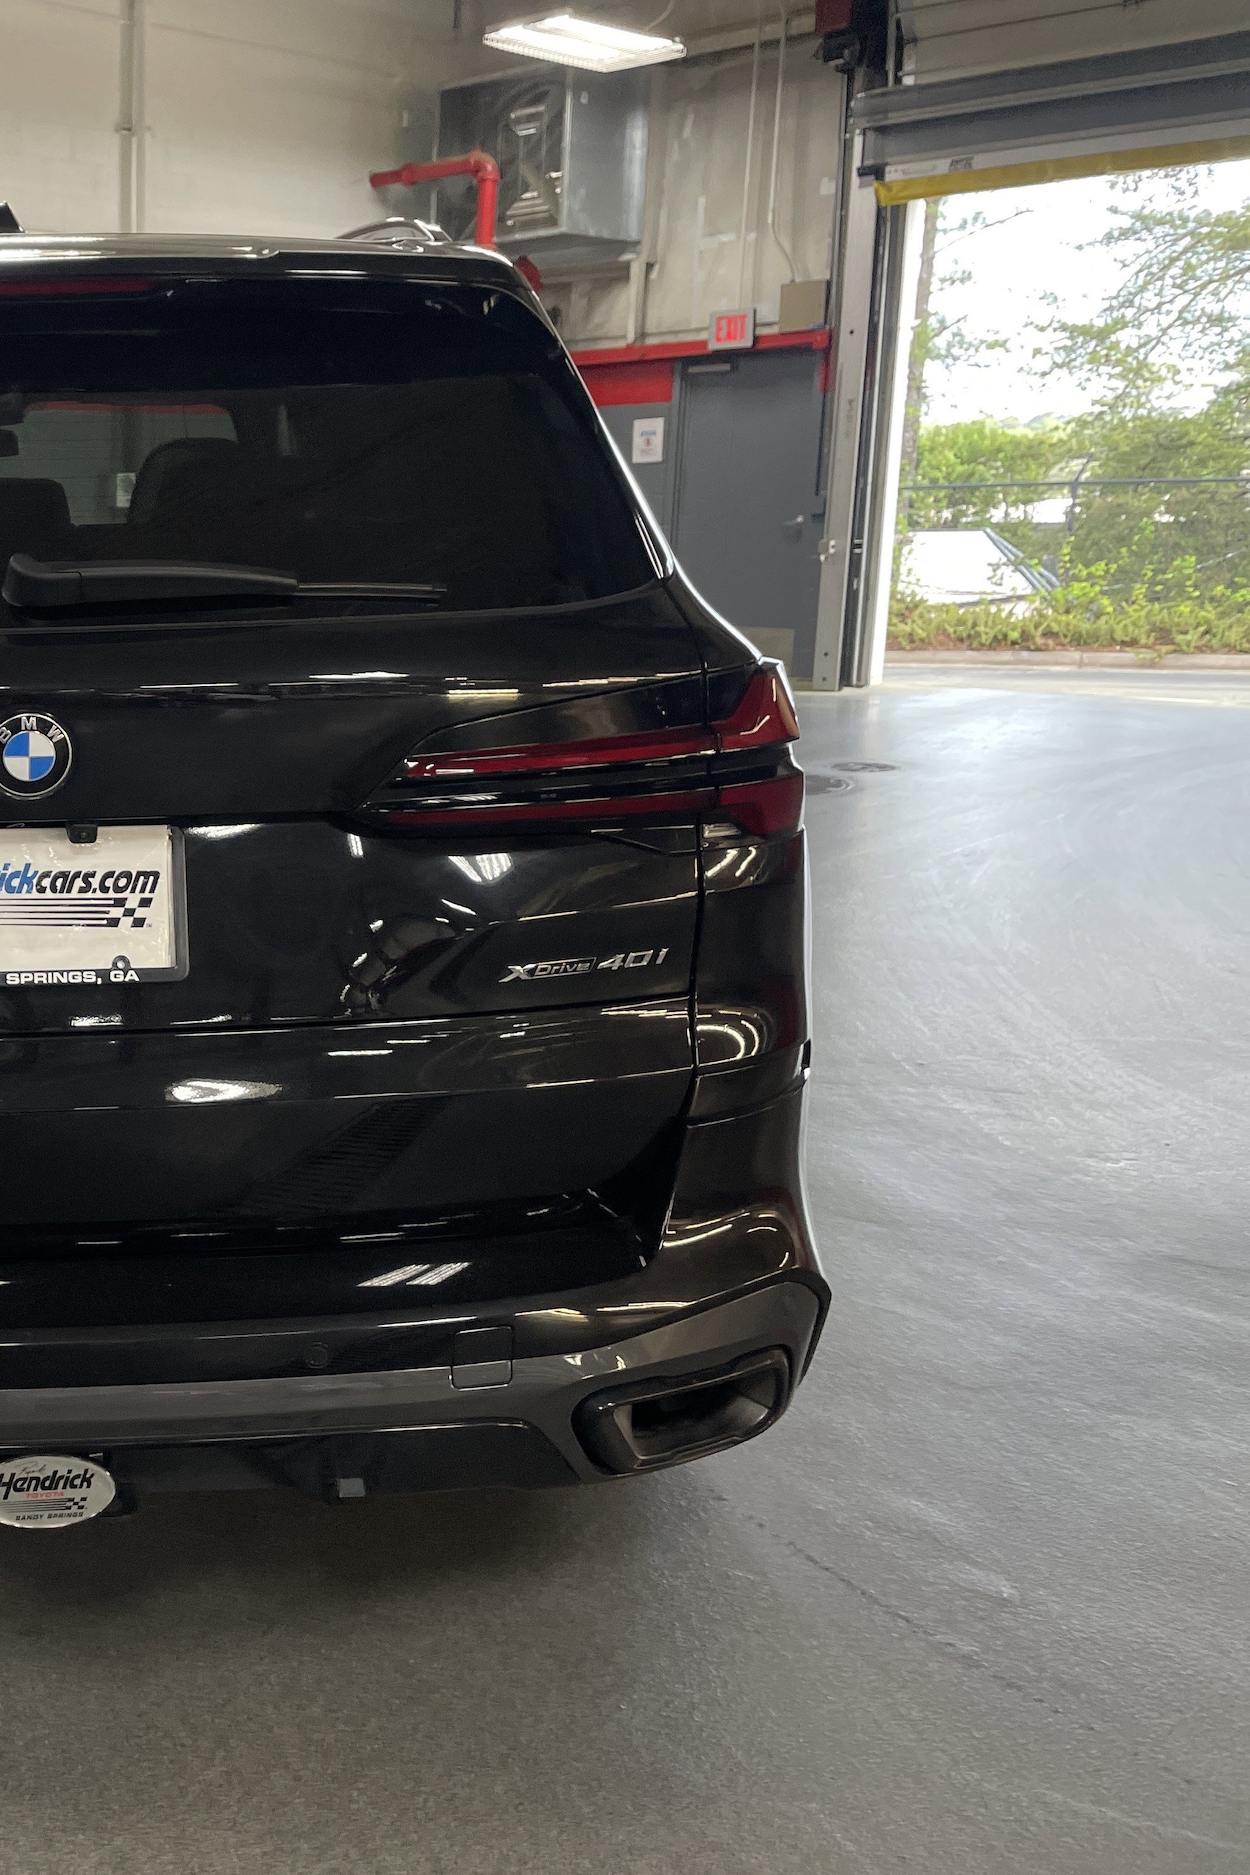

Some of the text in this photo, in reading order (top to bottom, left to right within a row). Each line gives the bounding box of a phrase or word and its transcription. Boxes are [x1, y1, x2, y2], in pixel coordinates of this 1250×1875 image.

[715, 314, 748, 344] EXIT
[5, 970, 102, 986] SPRINGS,
[109, 969, 140, 982] GA
[25, 1491, 65, 1499] TOYOTA
[47, 1511, 84, 1519] SPRINGS
